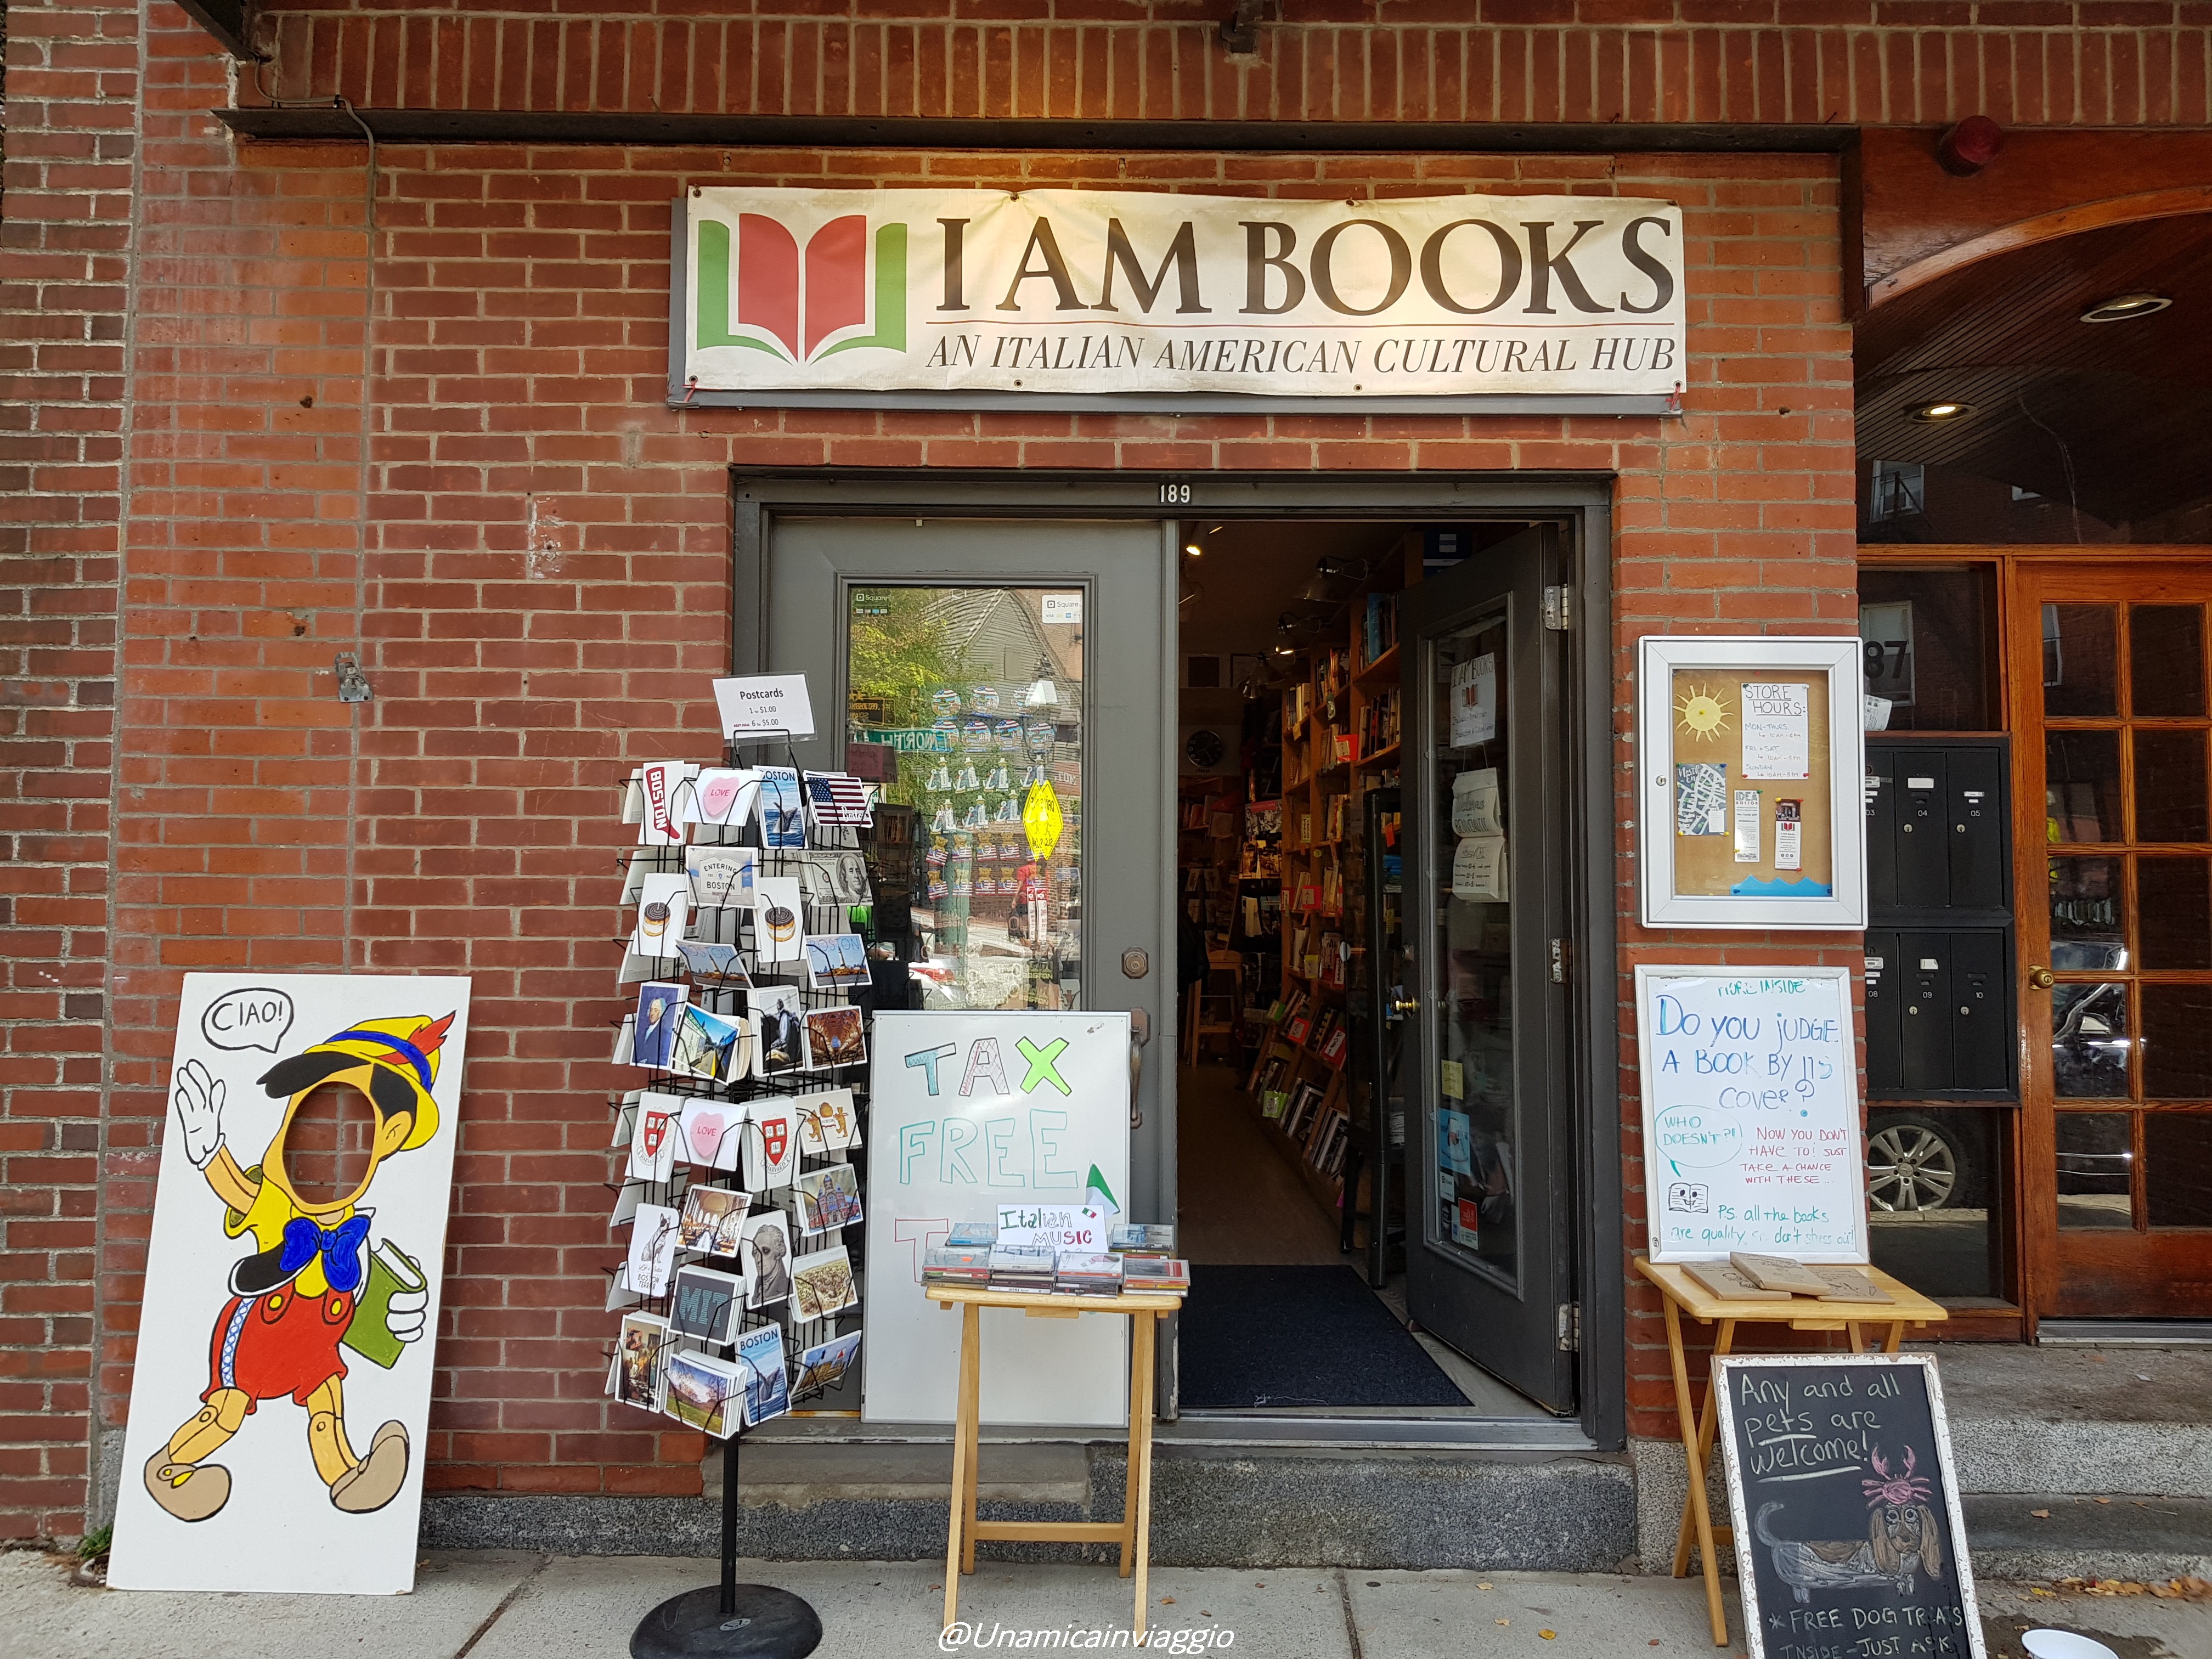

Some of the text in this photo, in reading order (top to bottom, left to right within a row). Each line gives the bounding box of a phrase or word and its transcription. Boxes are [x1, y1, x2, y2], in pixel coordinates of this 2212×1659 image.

[936, 216, 1675, 316] I AM BOOKS
[926, 335, 1677, 374] AN ITALIAN AMERICAN CULTURAL HUB
[1160, 484, 1190, 503] 189
[740, 687, 783, 700] Postcards
[1745, 685, 1792, 700] STORE
[759, 706, 777, 714] $1.00
[1752, 701, 1806, 715] HOURS:
[762, 718, 779, 726] $5.00
[650, 770, 668, 830] BOSTON
[710, 787, 731, 797] LOVE
[1736, 792, 1758, 801] IDEA
[840, 805, 868, 822] Boston
[707, 881, 735, 890] BOSTON
[810, 936, 861, 953] BOSTON
[1018, 993, 1049, 1006] BOSTON
[211, 1001, 283, 1030] CIAO!
[904, 1036, 1072, 1097] TAX
[1662, 1049, 1680, 1074] A
[1695, 1048, 1761, 1078] BOOK
[1768, 1053, 1793, 1081] BY
[1664, 1116, 1701, 1129] WHO
[697, 1126, 717, 1137] LOVE
[1757, 1126, 1847, 1142] NOW YOU DON'T
[899, 1109, 1079, 1189] FREE
[1795, 1163, 1832, 1171] CHANCE
[1745, 1176, 1771, 1184] WITH
[999, 1207, 1073, 1229] Italian
[1744, 1204, 1760, 1222] all
[1763, 1206, 1790, 1222] the
[1793, 1206, 1830, 1223] books
[1032, 1229, 1092, 1246] MUSIC
[1671, 1227, 1694, 1240] are
[1701, 1224, 1746, 1246] quality
[1774, 1226, 1802, 1244] don't
[637, 1273, 659, 1284] BOSTON
[680, 1285, 729, 1328] MIT
[740, 1328, 778, 1351] BOSTON
[1740, 1372, 1901, 1414] Any and all
[1743, 1409, 1881, 1449] pets are
[1789, 1605, 1963, 1633] FREE DOG TRAS
[1855, 1636, 1900, 1657] JUST
